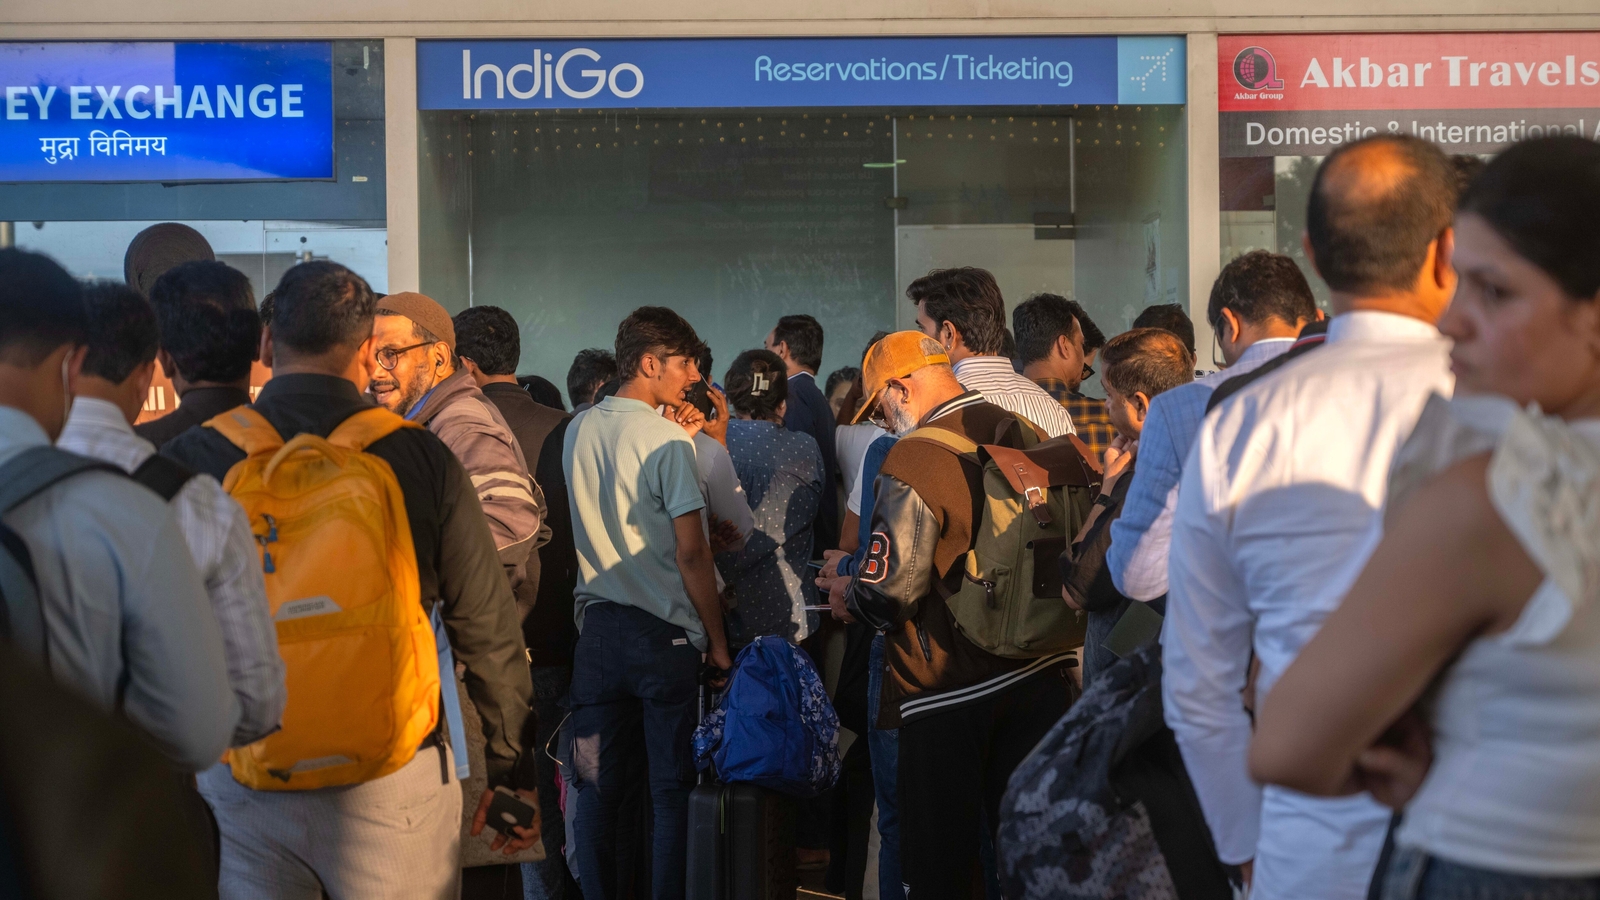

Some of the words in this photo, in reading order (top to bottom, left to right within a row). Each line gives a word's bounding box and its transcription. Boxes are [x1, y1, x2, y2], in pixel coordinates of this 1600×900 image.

[462, 47, 645, 100] IndiGo
[754, 54, 1073, 88] Reservations/Ticketing
[1300, 57, 1432, 88] Akbar
[1441, 55, 1600, 87] Travels
[70, 84, 304, 120] EXCHANGE
[1234, 92, 1258, 100] Akbar
[1259, 92, 1284, 101] Group
[39, 137, 80, 164] मुद्रा
[88, 129, 168, 156] विनिमय
[1246, 121, 1377, 145] Domestic
[859, 531, 891, 584] B
